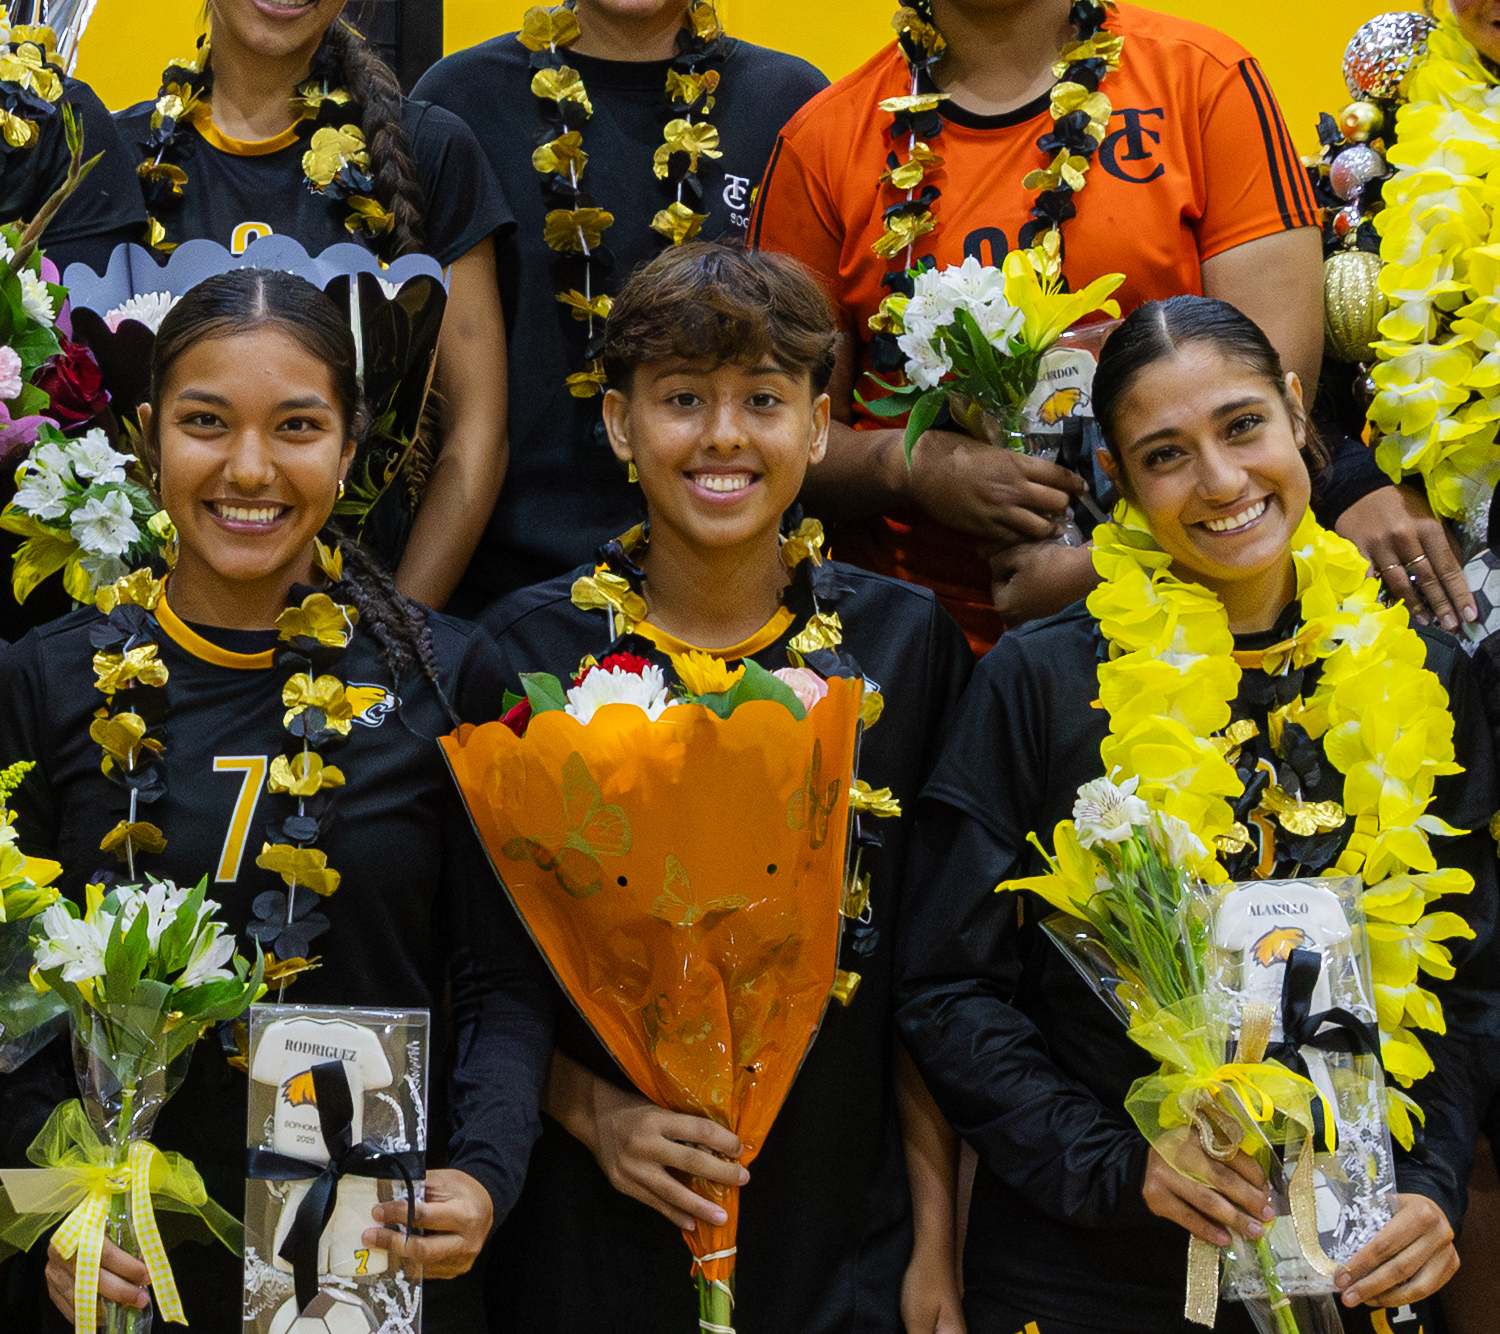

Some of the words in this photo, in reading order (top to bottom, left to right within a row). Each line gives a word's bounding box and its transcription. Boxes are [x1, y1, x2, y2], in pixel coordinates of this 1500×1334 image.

[730, 212, 750, 229] SOC
[213, 754, 268, 883] 7
[1249, 902, 1310, 917] ALAMILLO
[284, 1038, 357, 1063] RODRIGUEZ
[284, 1119, 321, 1132] SOPHOMO
[353, 1248, 369, 1275] 7
